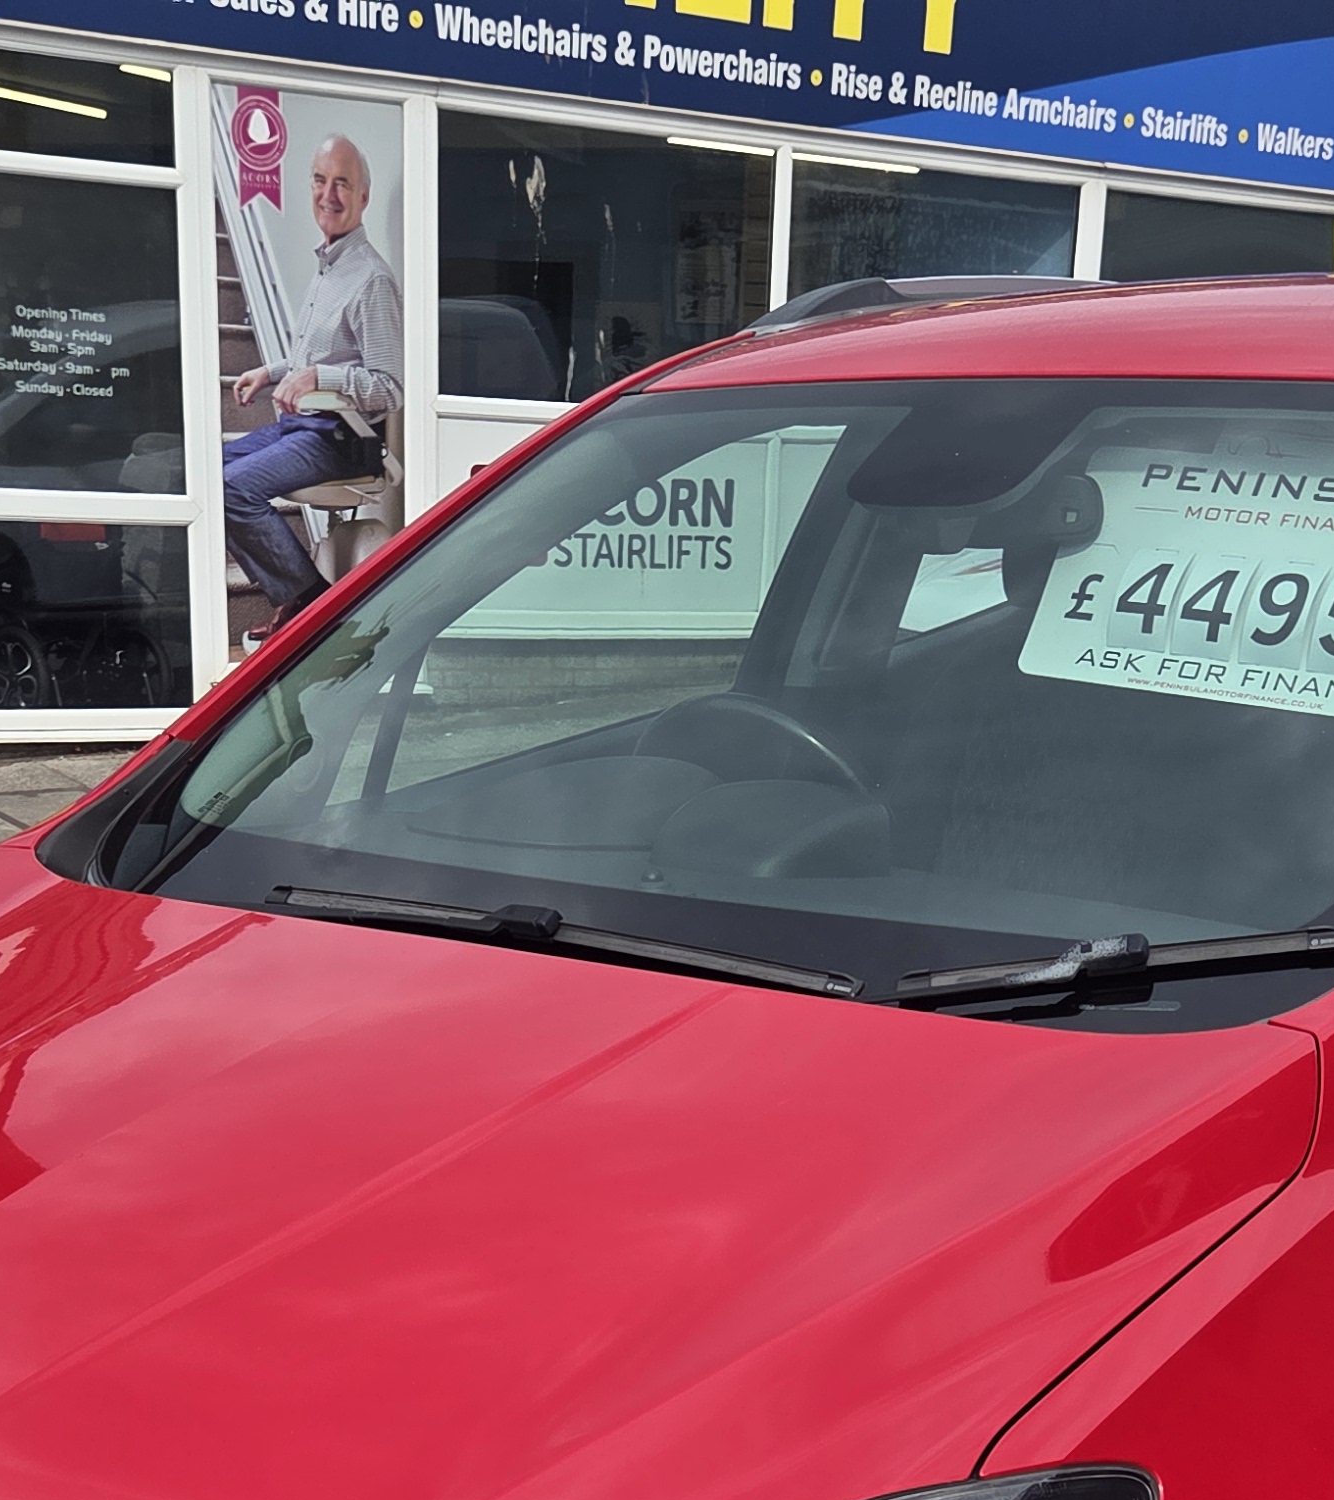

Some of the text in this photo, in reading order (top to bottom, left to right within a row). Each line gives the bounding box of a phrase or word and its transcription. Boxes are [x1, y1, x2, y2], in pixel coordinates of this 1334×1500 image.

[338, 0, 399, 33] Hire
[434, 2, 608, 66] Wheelchairs
[613, 30, 636, 67] &
[643, 34, 802, 91] Powerchairs
[830, 62, 883, 102] Rise
[888, 70, 908, 106] &
[913, 74, 998, 118] Recline
[1002, 87, 1117, 134] Armchairs
[1140, 106, 1228, 149] Stairlifts
[1257, 121, 1334, 162] Walkers
[14, 304, 106, 323] Opening Times
[10, 324, 63, 343] Monday
[71, 329, 113, 346] Friday
[29, 339, 59, 354] 9am
[67, 342, 96, 358] 5pm
[65, 362, 94, 375] 9am
[15, 380, 64, 397] Sunday
[72, 383, 114, 397] Closed
[1184, 504, 1271, 527] MOTOR
[553, 532, 733, 571] STAIRLIFTS
[1074, 647, 1147, 674] ASK
[1156, 657, 1229, 685] FOR
